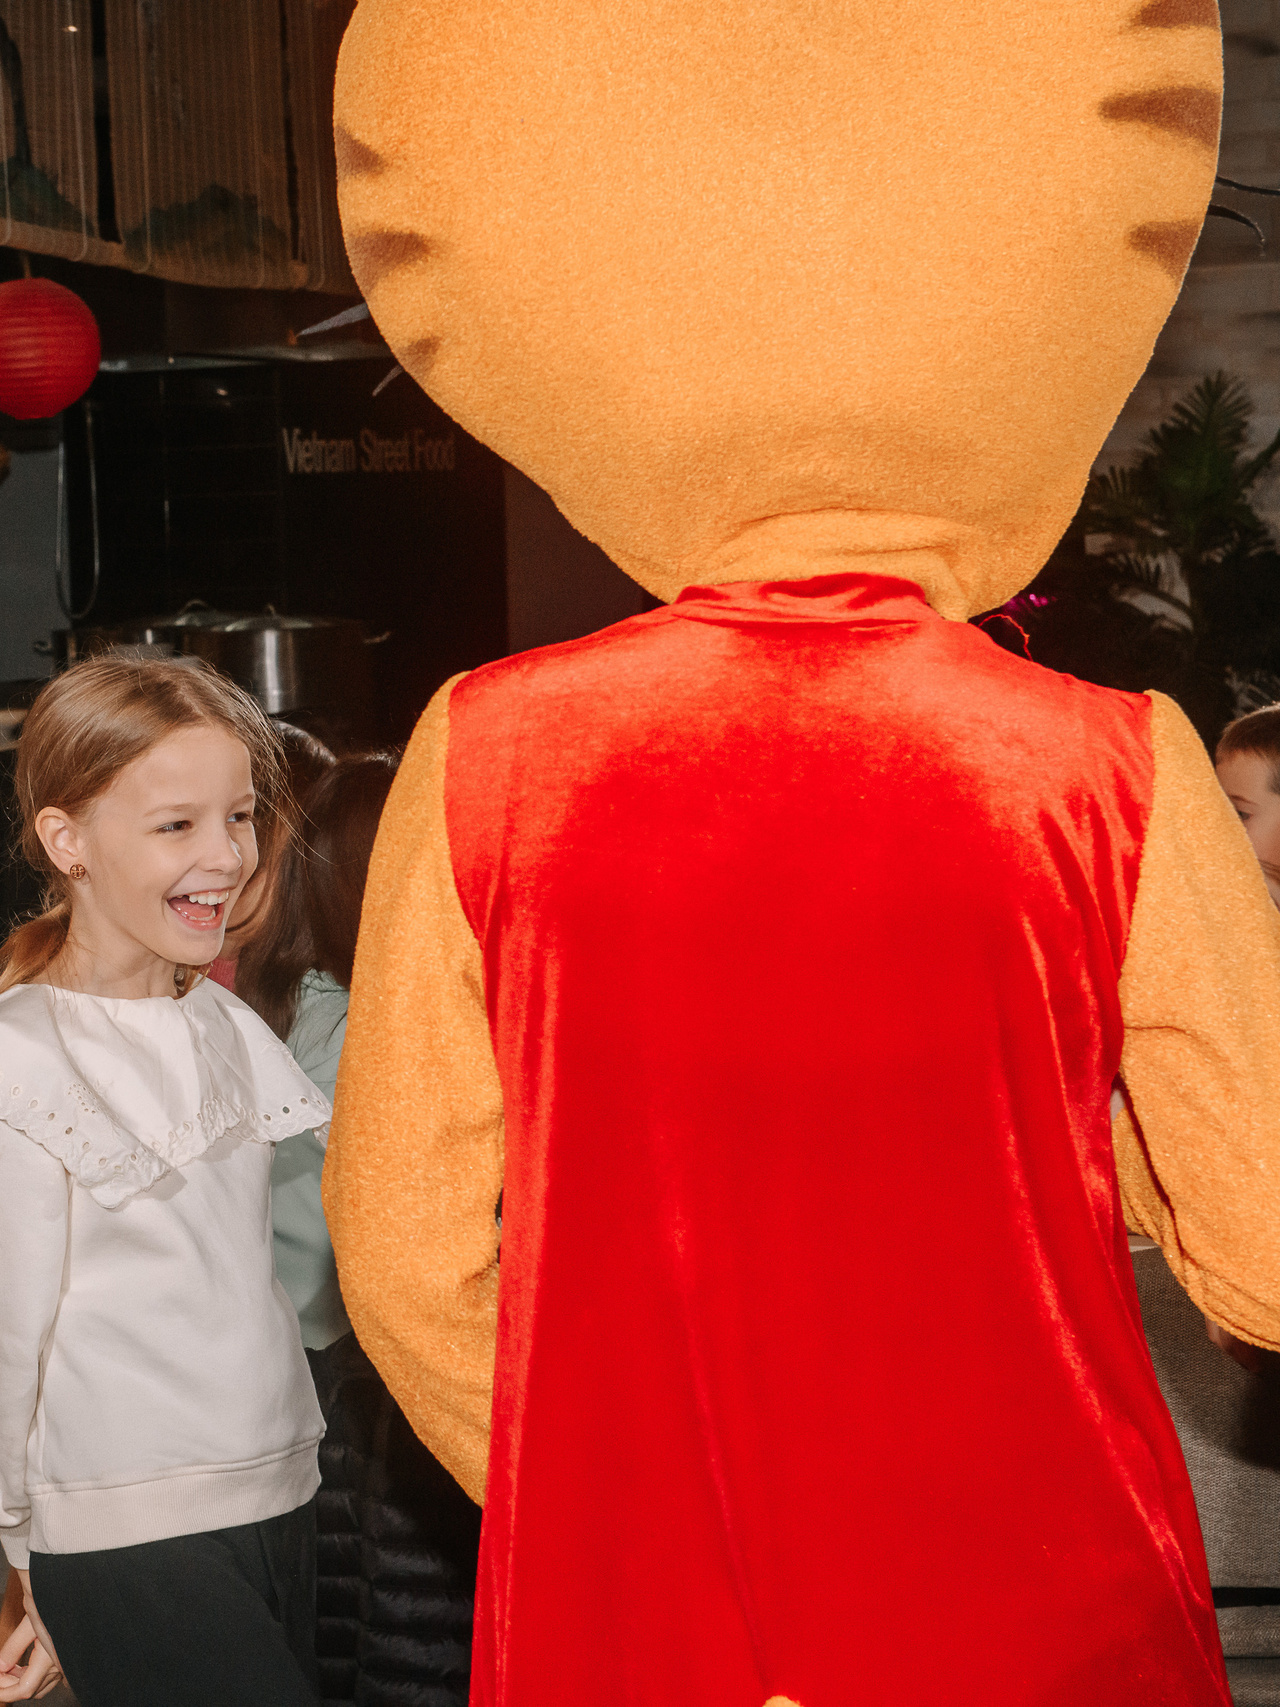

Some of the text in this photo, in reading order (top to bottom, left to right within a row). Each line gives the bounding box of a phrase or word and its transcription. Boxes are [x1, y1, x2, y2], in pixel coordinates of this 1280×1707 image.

[281, 427, 456, 473] Vietnam Street Food
